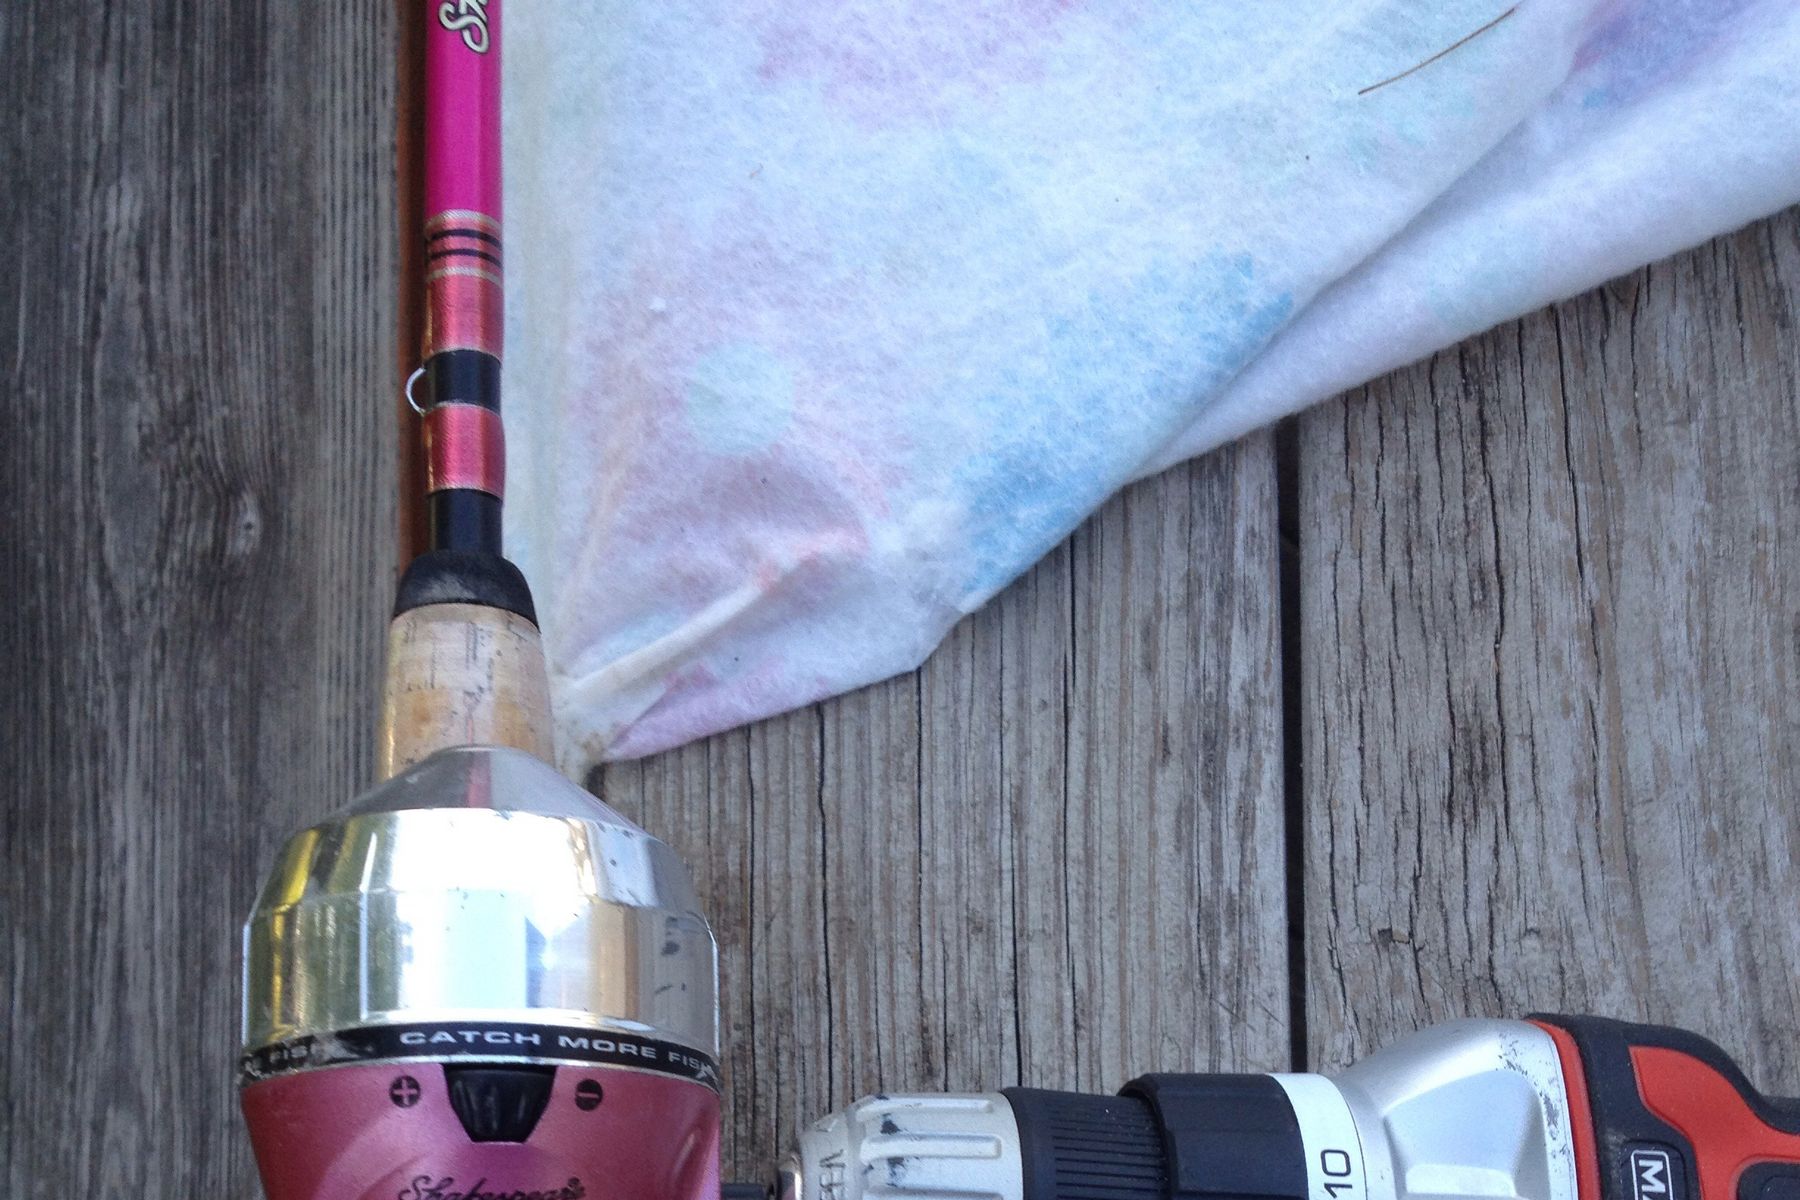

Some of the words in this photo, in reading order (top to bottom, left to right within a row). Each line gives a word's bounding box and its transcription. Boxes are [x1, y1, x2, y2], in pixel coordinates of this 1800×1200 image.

[400, 1031, 542, 1047] CATCH
[558, 1035, 657, 1059] MORE
[1320, 1149, 1353, 1199] 10
